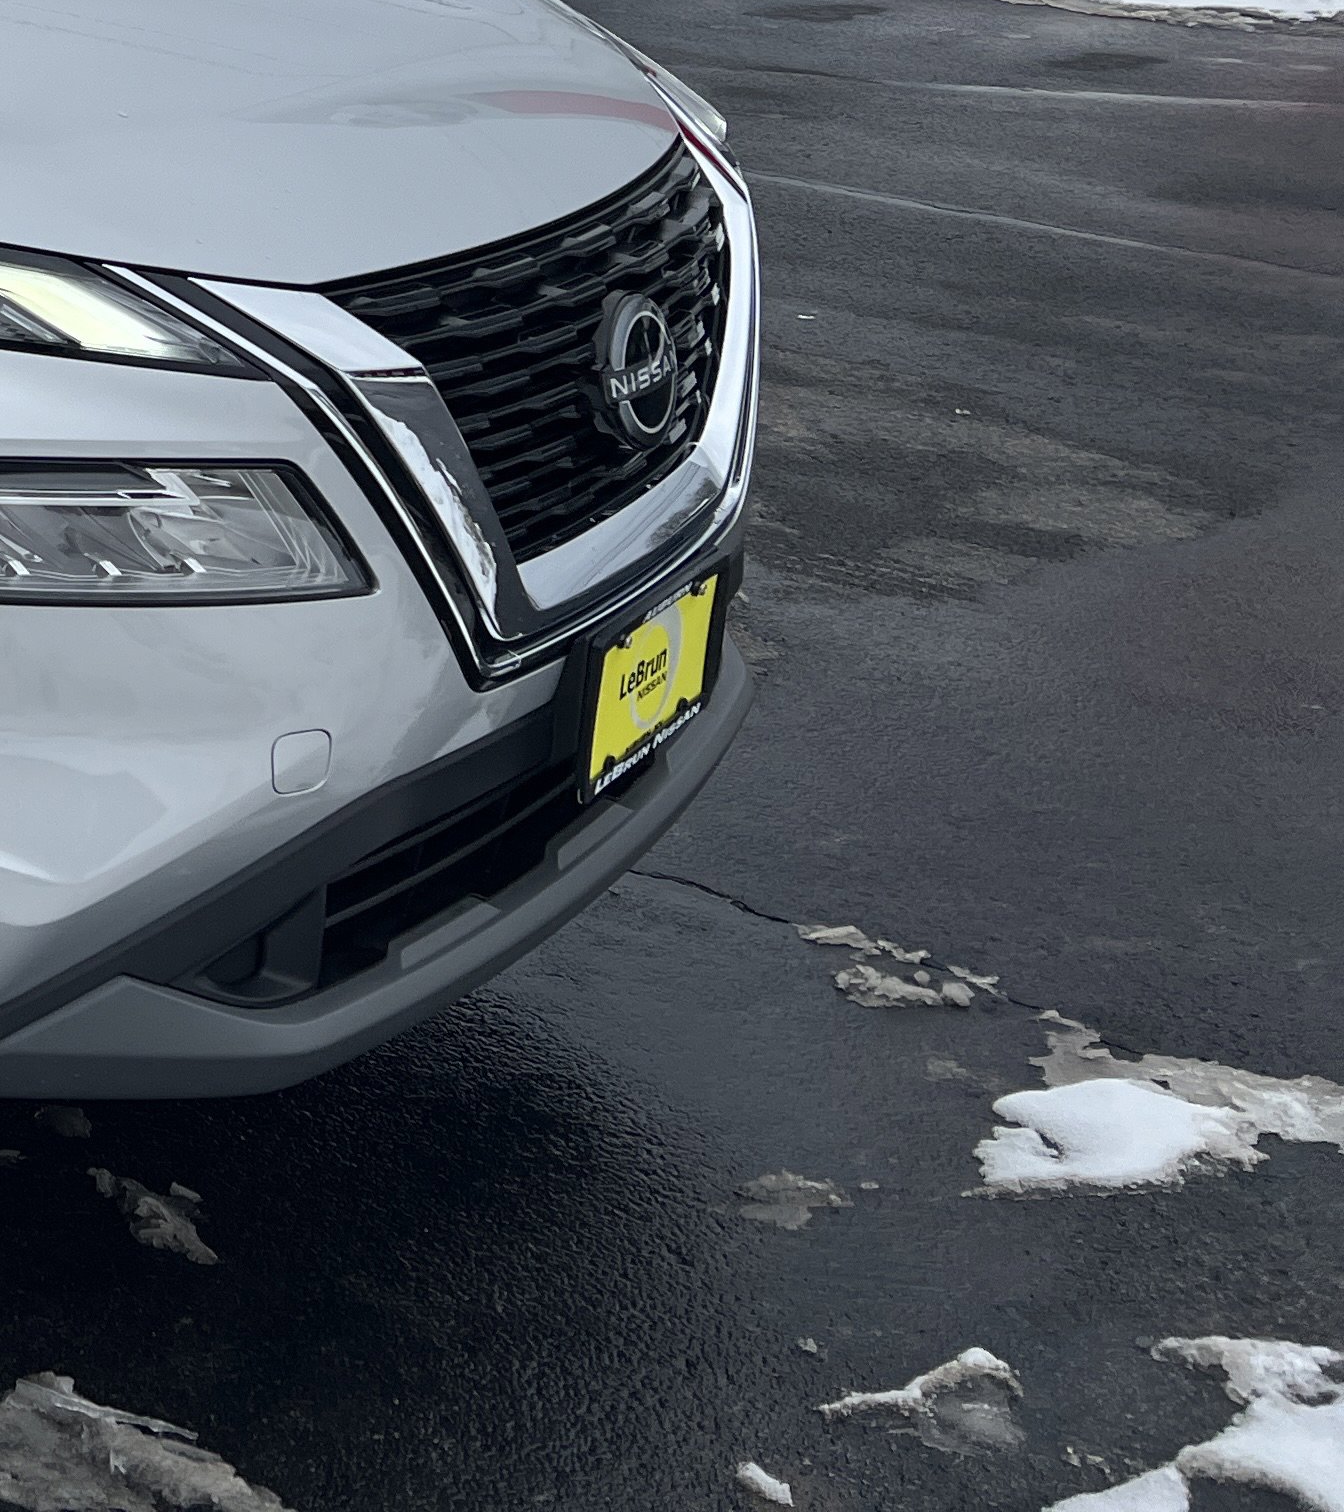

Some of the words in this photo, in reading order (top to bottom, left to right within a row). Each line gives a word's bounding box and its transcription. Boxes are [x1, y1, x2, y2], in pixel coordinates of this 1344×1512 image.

[619, 648, 667, 701] LeBrun
[594, 743, 651, 796] LEBRUN
[652, 702, 701, 749] NISSAN
